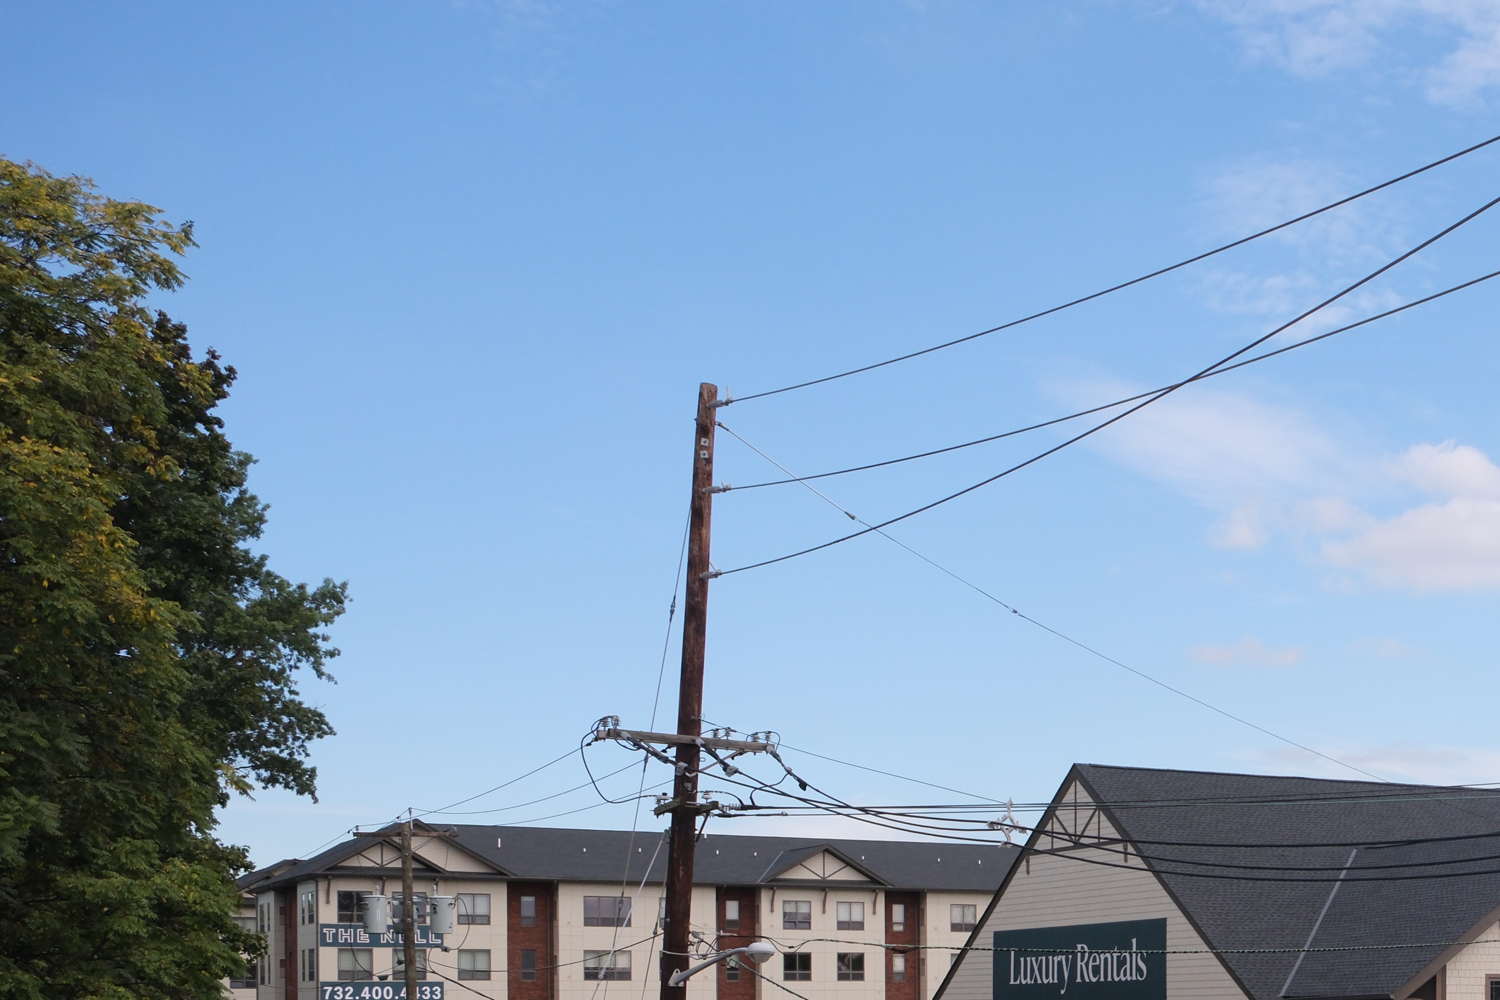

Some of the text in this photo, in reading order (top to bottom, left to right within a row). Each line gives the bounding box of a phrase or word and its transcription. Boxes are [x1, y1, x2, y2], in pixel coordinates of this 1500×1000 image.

[323, 928, 370, 944] THE
[1009, 937, 1147, 995] Luxury Rentals
